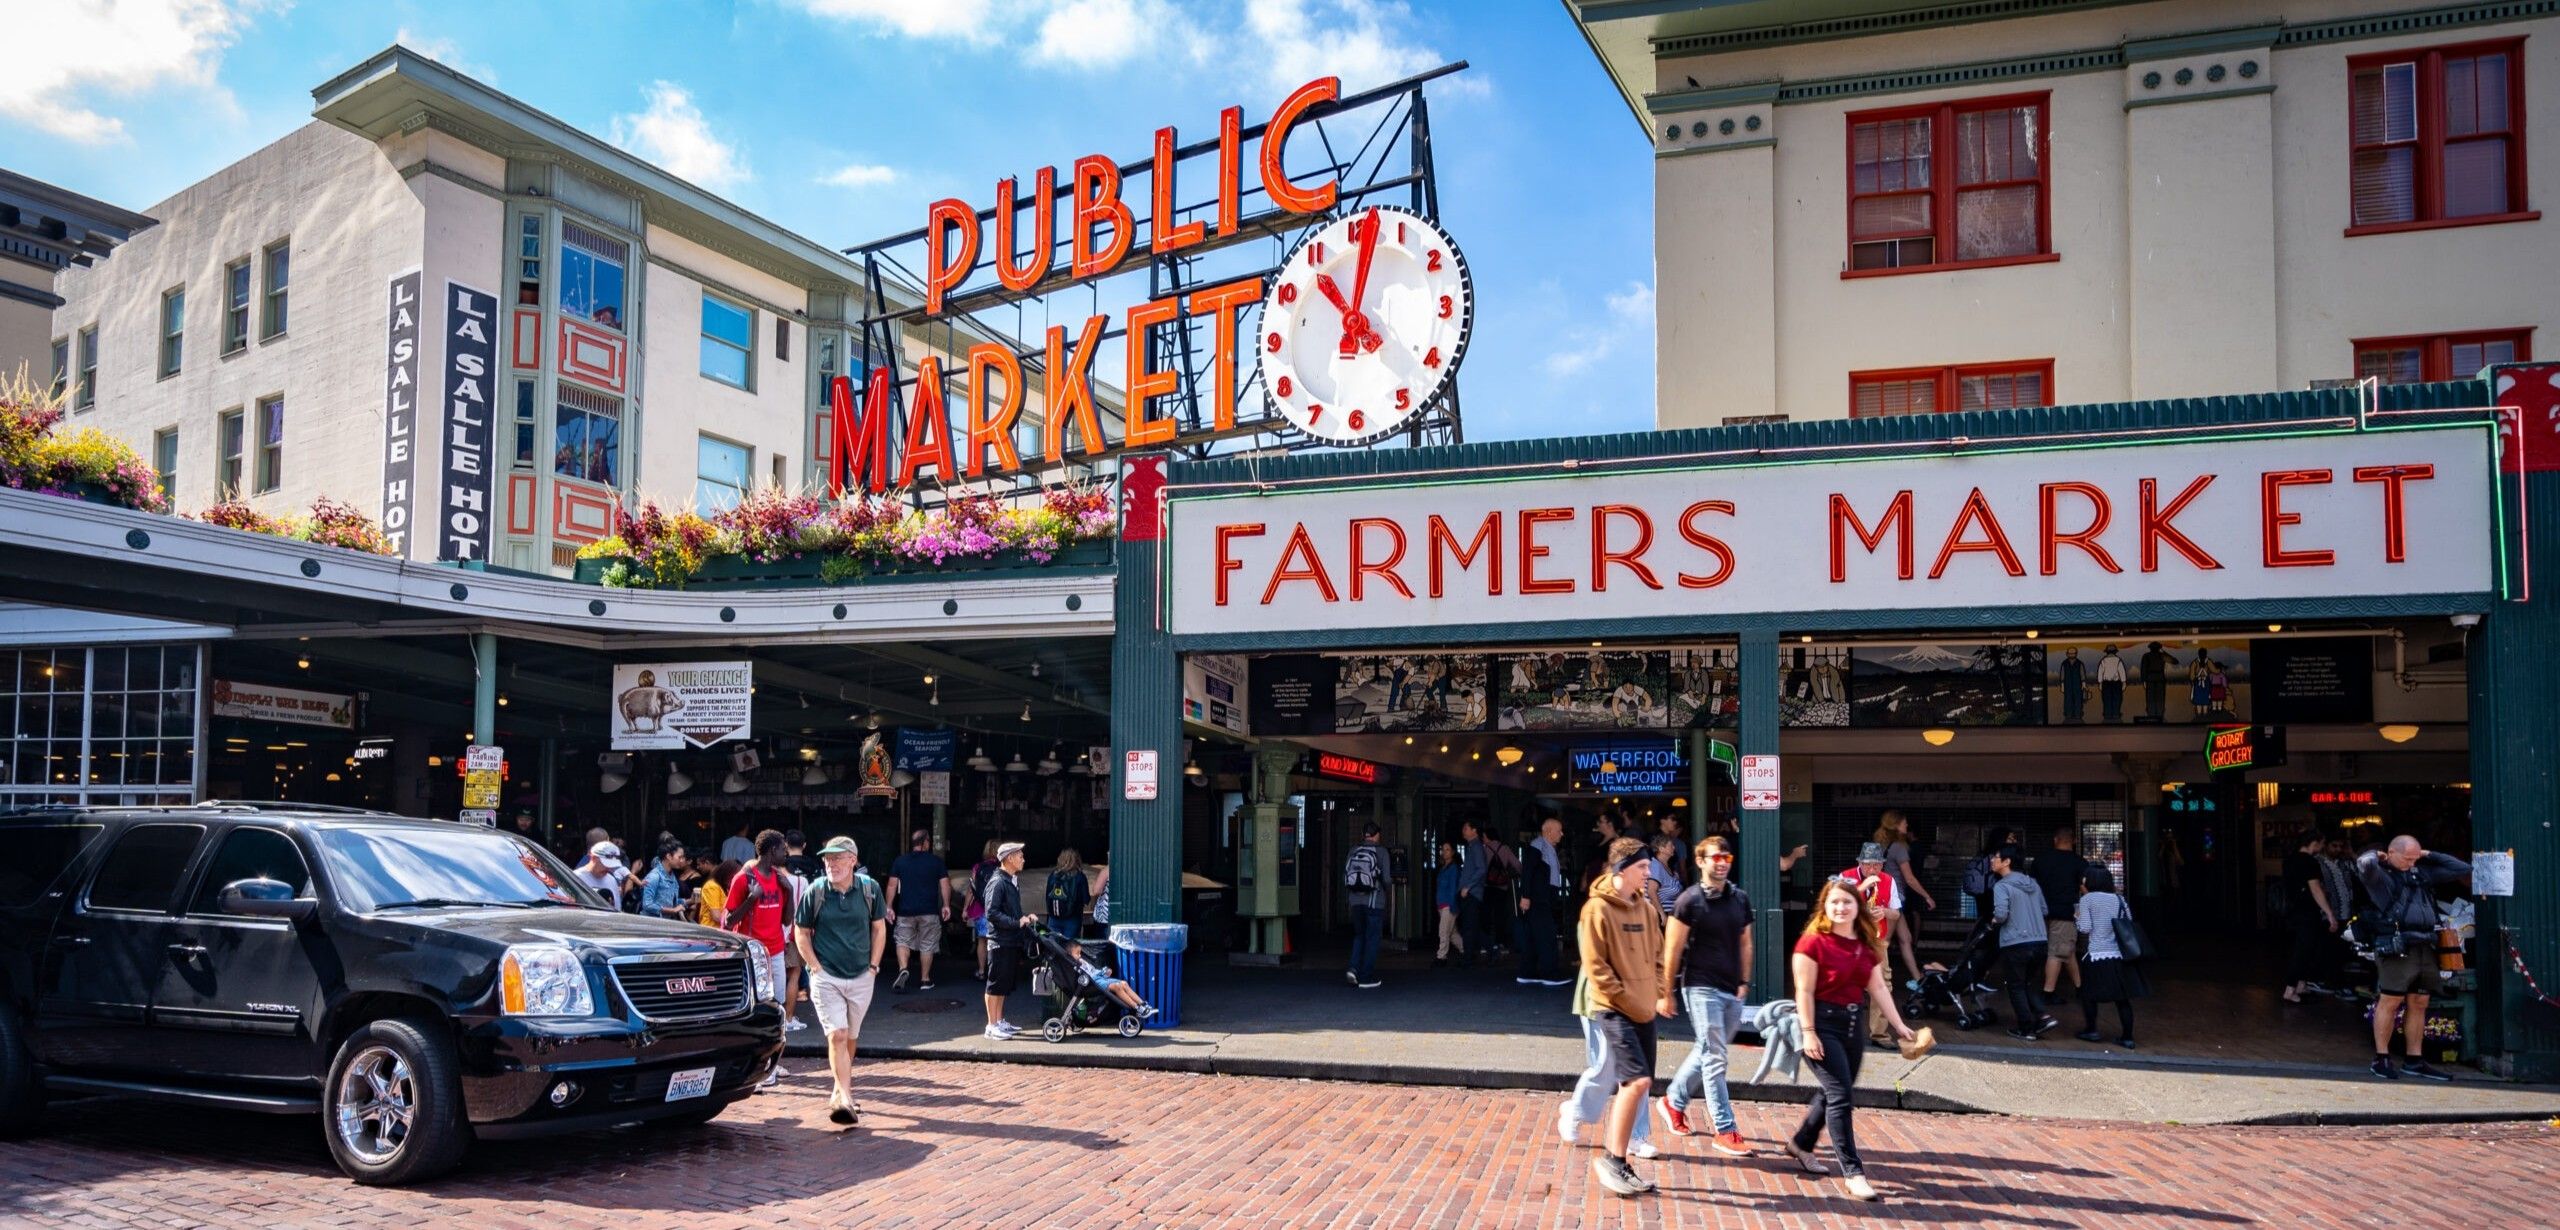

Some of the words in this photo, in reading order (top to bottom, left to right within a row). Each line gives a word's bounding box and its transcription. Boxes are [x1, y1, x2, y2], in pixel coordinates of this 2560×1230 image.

[926, 76, 1341, 315] PUBLIC
[1398, 222, 1406, 245] 1
[1308, 242, 1324, 266] 11
[1427, 249, 1442, 273] 2
[1278, 283, 1297, 306] 10
[393, 284, 414, 332] LA
[455, 290, 488, 344] LA
[1438, 295, 1453, 319] 3
[1267, 332, 1281, 353] 9
[1423, 346, 1441, 369] 4
[829, 277, 1263, 498] MARKET
[1277, 376, 1293, 398] 8
[390, 338, 413, 463] SALLE
[1395, 388, 1410, 410] 5
[451, 353, 485, 475] SALLE
[1308, 404, 1323, 425] 7
[1348, 409, 1364, 431] 6
[386, 479, 407, 559] HOT
[1215, 501, 1736, 606] FARMERS
[1829, 463, 2434, 583] MARKET
[668, 670, 698, 687] YOUR
[699, 669, 748, 686] CHANGE
[250, 709, 269, 718] DRIED
[2216, 731, 2245, 749] ROTARY
[1130, 763, 1153, 771] STOPS
[1575, 751, 1688, 769] WATERFRON
[1744, 758, 1755, 766] NO
[2211, 746, 2253, 767] GROCERY
[1590, 770, 1676, 784] VIEWPOINT
[1747, 768, 1774, 777] STOPS
[1633, 784, 1663, 792] SEATING
[665, 976, 718, 995] GMC
[284, 1005, 301, 1013] XL
